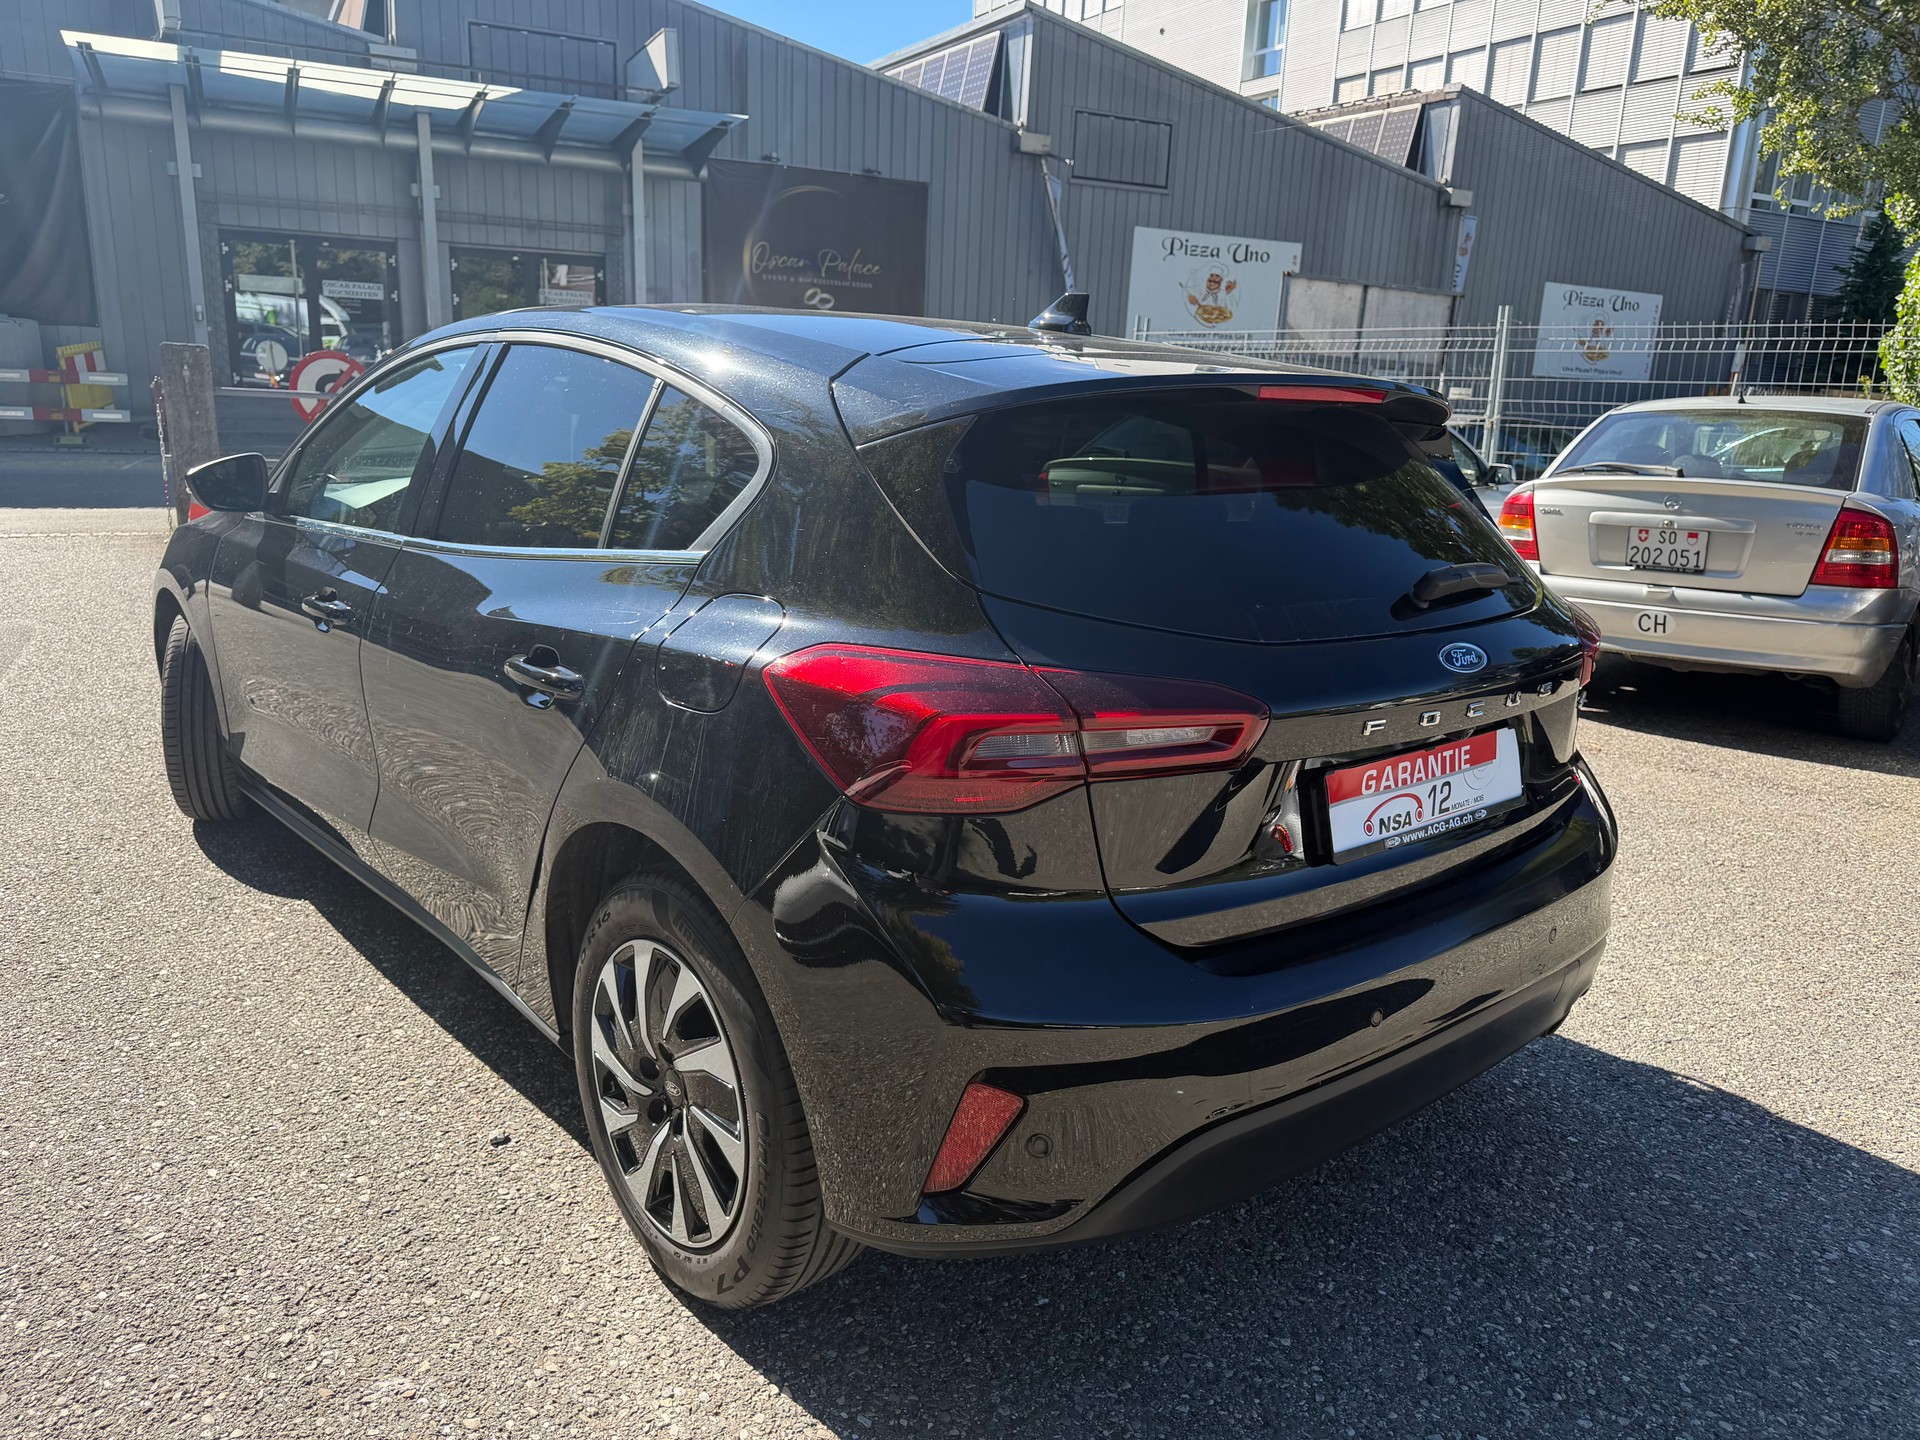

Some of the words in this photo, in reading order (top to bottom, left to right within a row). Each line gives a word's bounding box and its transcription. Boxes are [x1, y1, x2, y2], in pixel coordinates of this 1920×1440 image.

[752, 241, 811, 274] Oscar
[818, 248, 882, 280] Palace
[1161, 236, 1220, 261] Pizza
[1227, 243, 1270, 263] Uno
[323, 281, 350, 289] OSCAR
[762, 273, 787, 282] EVENT
[1563, 290, 1604, 310] Pizza
[1609, 295, 1640, 312] Uno
[1658, 530, 1677, 545] SO
[1638, 613, 1667, 634] CH
[1451, 649, 1478, 667] Ford
[1362, 682, 1553, 736] FOCUS
[1361, 745, 1471, 796] GARANTIE
[1427, 780, 1452, 817] 12
[1451, 799, 1471, 811] MONATE
[1378, 810, 1412, 835] NSA
[1402, 814, 1474, 844] www.ACG-AG.ch
